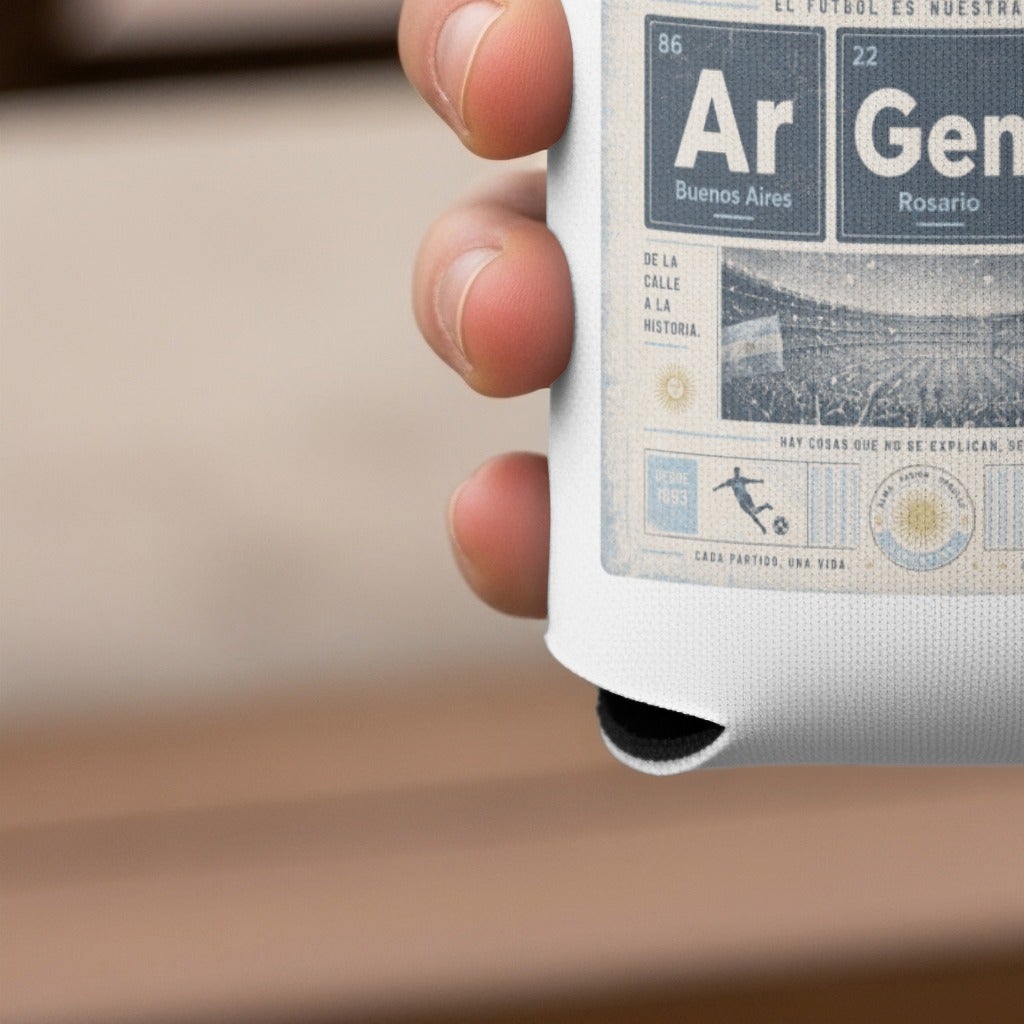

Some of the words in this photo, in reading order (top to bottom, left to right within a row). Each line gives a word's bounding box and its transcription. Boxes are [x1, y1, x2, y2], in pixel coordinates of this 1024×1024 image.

[658, 33, 682, 55] 86
[852, 45, 878, 66] 22
[674, 68, 794, 175] Ar
[675, 179, 741, 206] Buenos
[745, 185, 793, 208] Aires
[899, 190, 981, 212] Rosario
[644, 252, 659, 266] DE
[663, 254, 678, 268] LA
[644, 274, 681, 291] CALLE
[644, 296, 652, 310] A
[656, 297, 671, 312] LA
[643, 318, 701, 337] HISTORIA.
[780, 436, 803, 449] HAY
[808, 437, 849, 451] COSAS
[853, 439, 879, 452] QUE
[884, 440, 901, 452] NO
[907, 440, 924, 453] SE
[1007, 439, 1024, 452] SE
[695, 550, 724, 564] CADA
[788, 557, 811, 570] UNA
